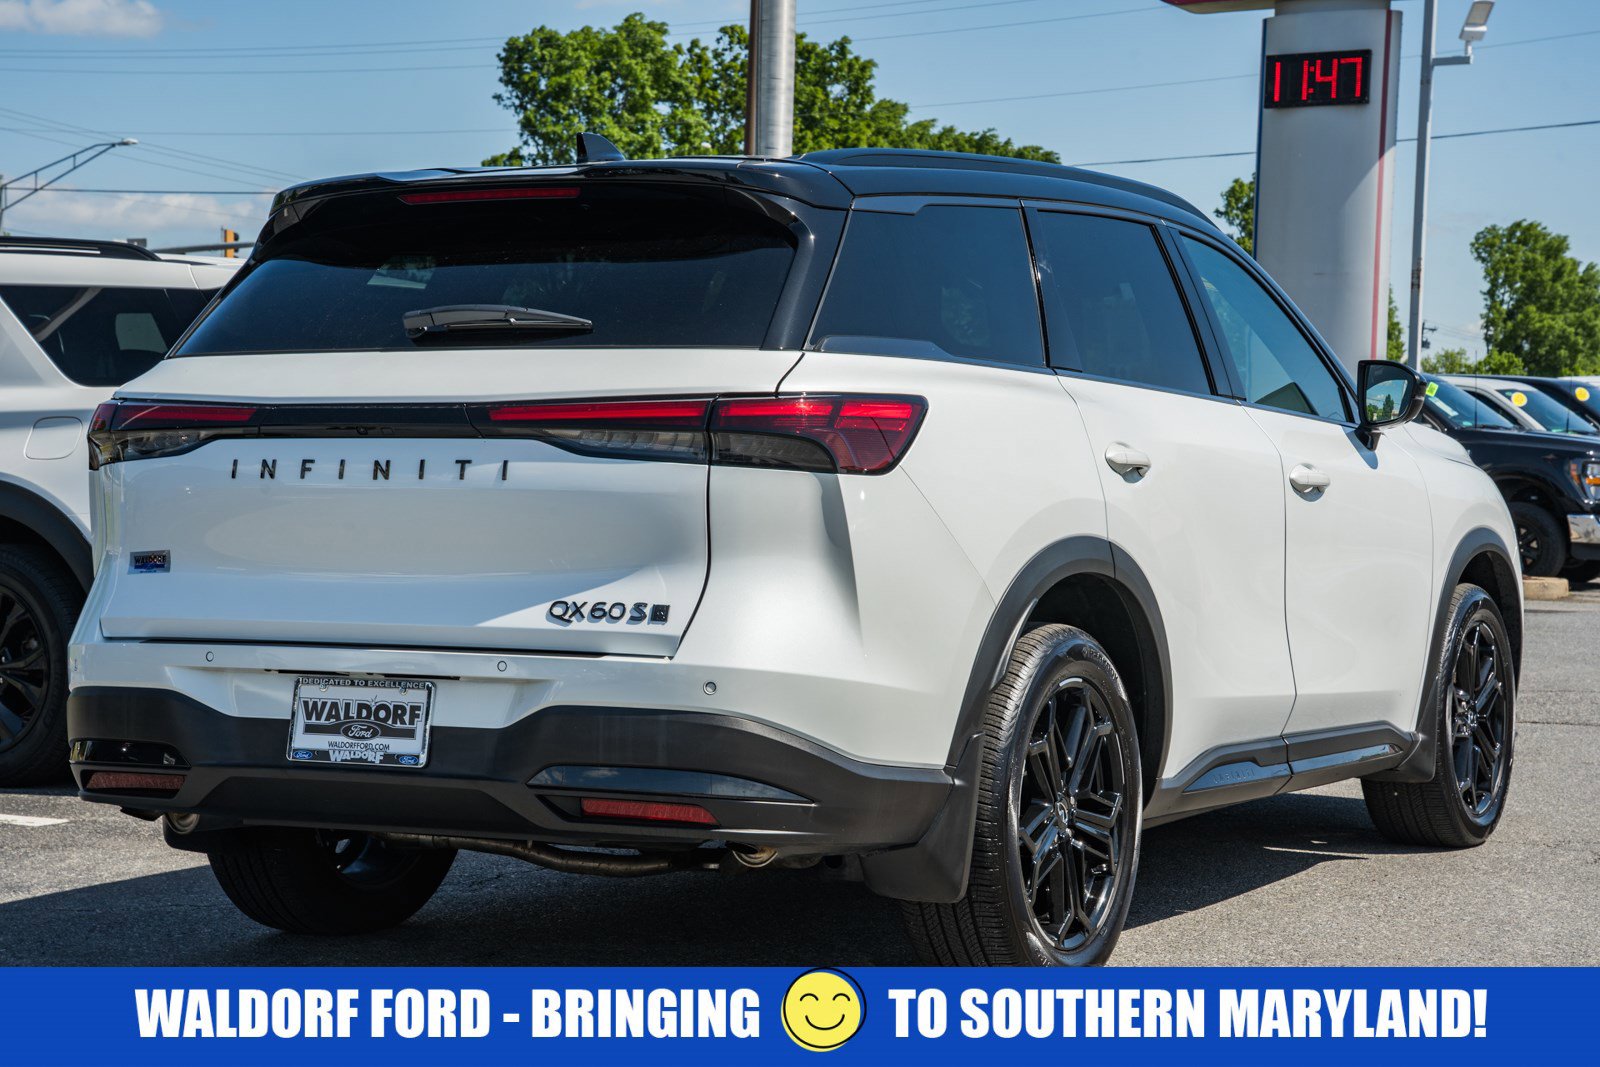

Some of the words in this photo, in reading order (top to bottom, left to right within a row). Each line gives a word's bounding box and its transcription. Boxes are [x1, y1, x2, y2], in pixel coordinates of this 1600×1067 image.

[1274, 57, 1362, 102] 11:47
[231, 459, 509, 480] INFINITI
[302, 678, 351, 686] DEDICATED
[354, 679, 366, 687] TO
[367, 680, 426, 689] EXCELLENCE
[301, 699, 423, 726] WALDORF
[348, 724, 373, 738] Ford
[328, 741, 390, 751] WALDORFFORD.COM
